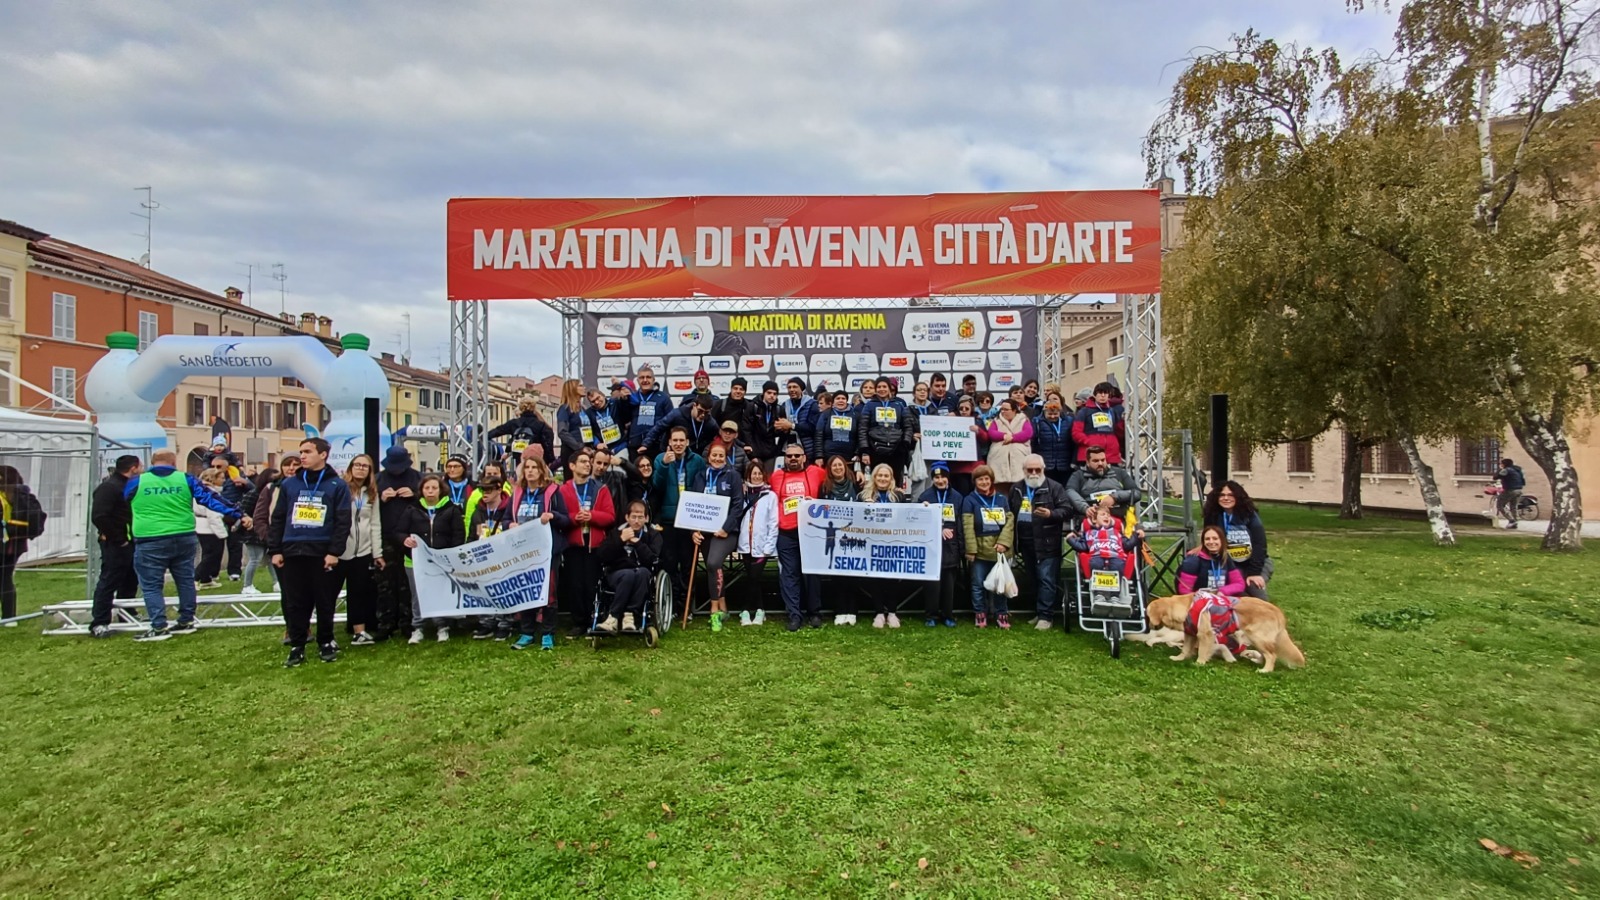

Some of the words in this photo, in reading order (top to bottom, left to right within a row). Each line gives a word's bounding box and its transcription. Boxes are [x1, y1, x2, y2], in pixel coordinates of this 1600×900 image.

[473, 227, 684, 270] MARATONA
[695, 226, 732, 268] DI
[744, 226, 924, 268] RAVENNA
[933, 216, 1020, 265] CITTÀ
[1025, 221, 1134, 264] D'ARTE
[728, 314, 804, 332] MARATONA
[807, 314, 821, 331] DI
[824, 313, 886, 330] RAVENNA
[764, 332, 802, 350] CITTÀ
[806, 333, 851, 349] D'ARTE
[923, 430, 941, 438] COOP
[942, 430, 970, 438] SOCIALE
[144, 486, 182, 496] STAFF
[299, 511, 318, 519] 9500
[870, 544, 926, 560] CORRENDO
[834, 556, 868, 571] SENZA
[870, 560, 926, 574] FRONTIERE
[484, 568, 546, 598] CORRENDO
